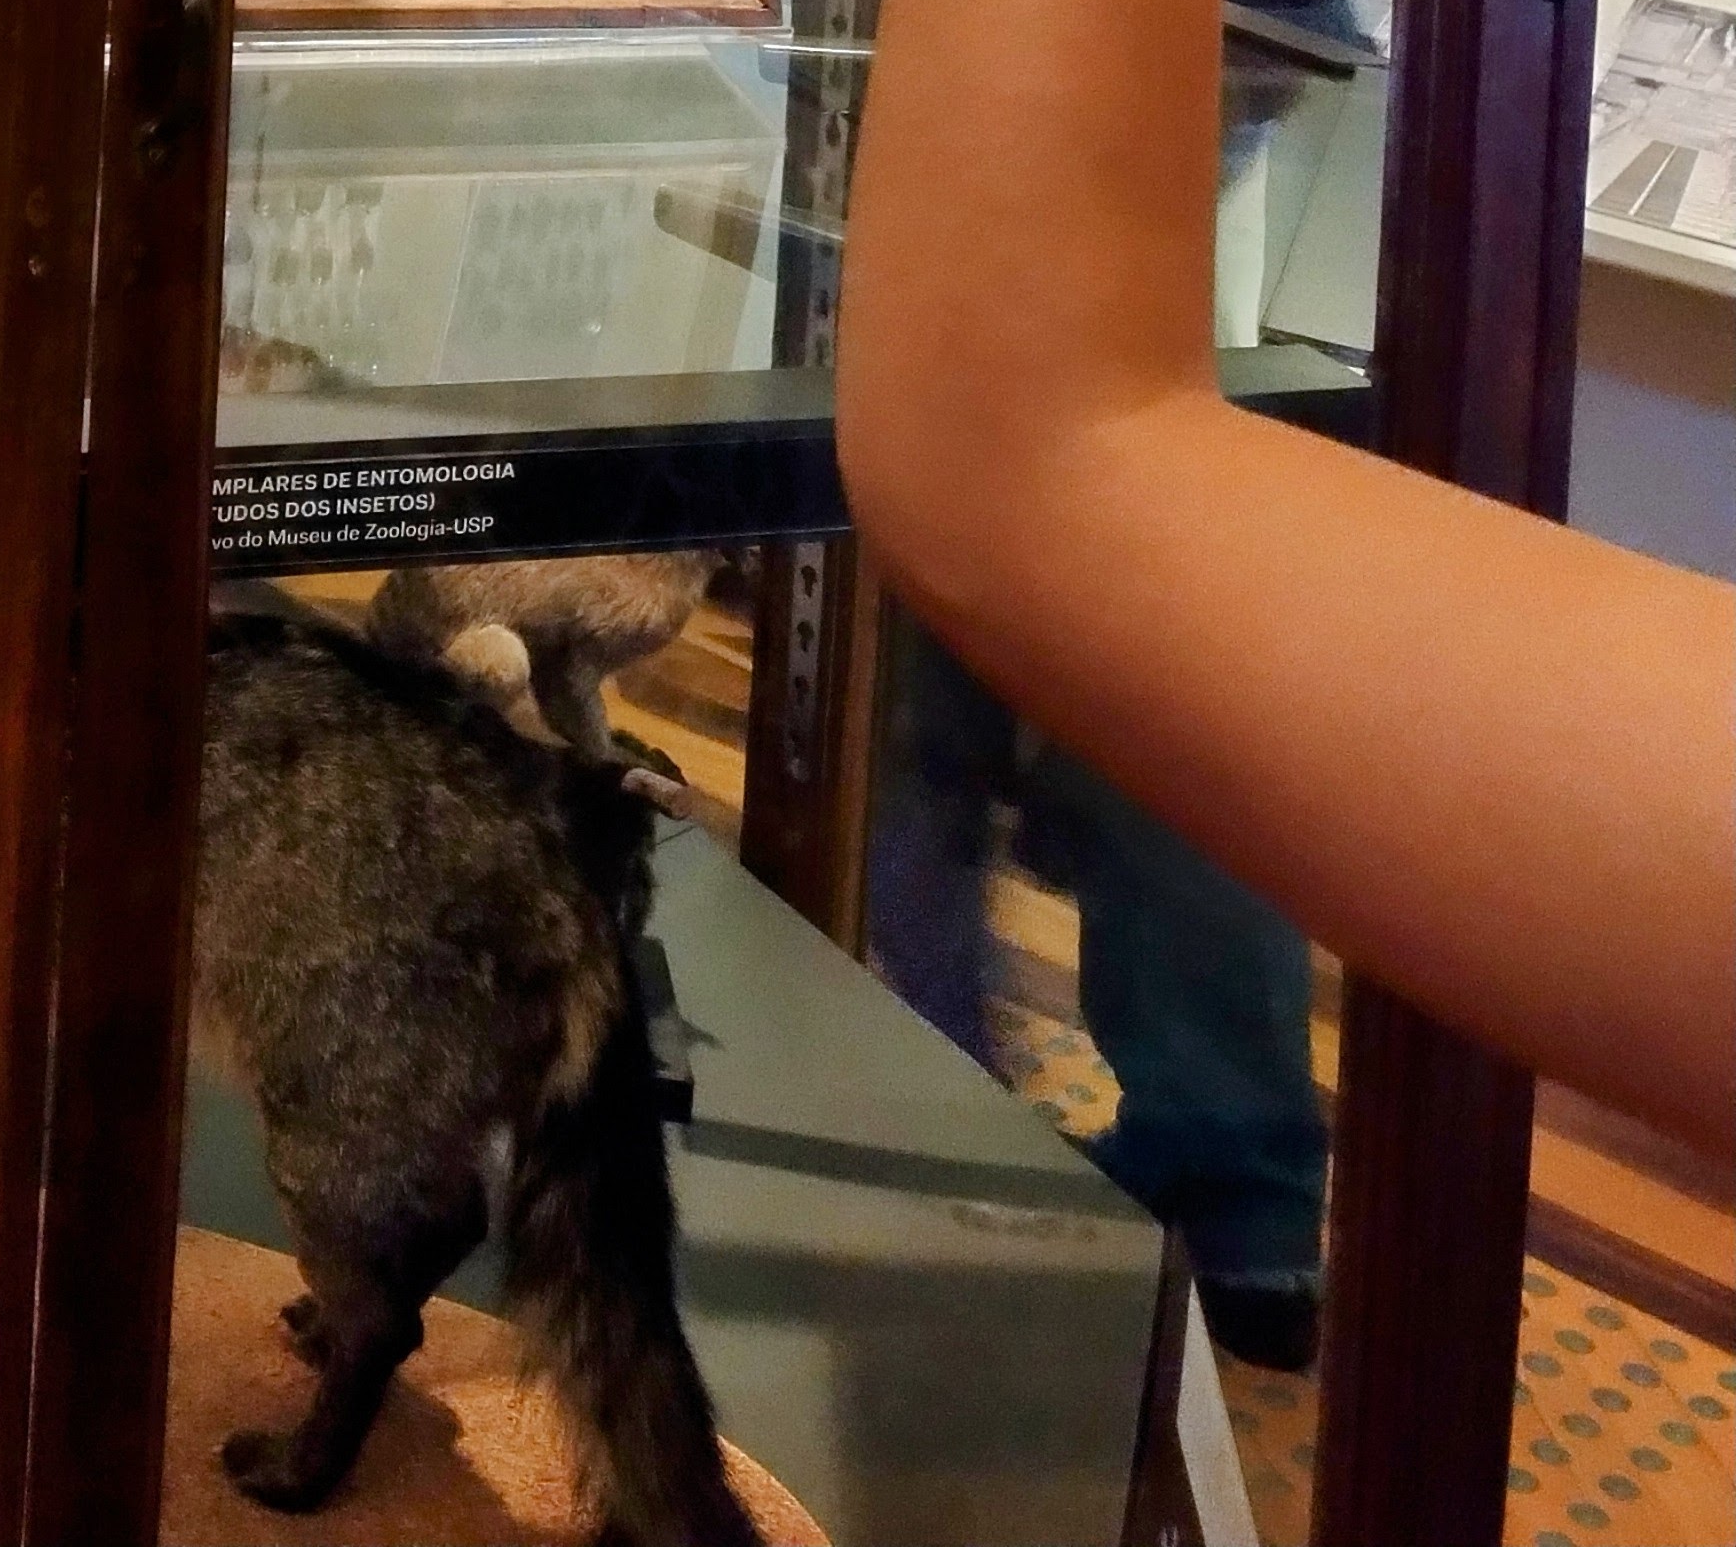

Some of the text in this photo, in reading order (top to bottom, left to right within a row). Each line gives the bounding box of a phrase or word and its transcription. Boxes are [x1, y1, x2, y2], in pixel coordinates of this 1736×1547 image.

[212, 462, 516, 497] MPLARES DE ENTOMOLOGIA
[211, 492, 436, 523] UDOS DOS INSETOS)
[238, 530, 263, 549] do
[267, 525, 332, 546] Museu
[336, 524, 361, 542] de
[364, 515, 495, 542] Zoologia-USP
